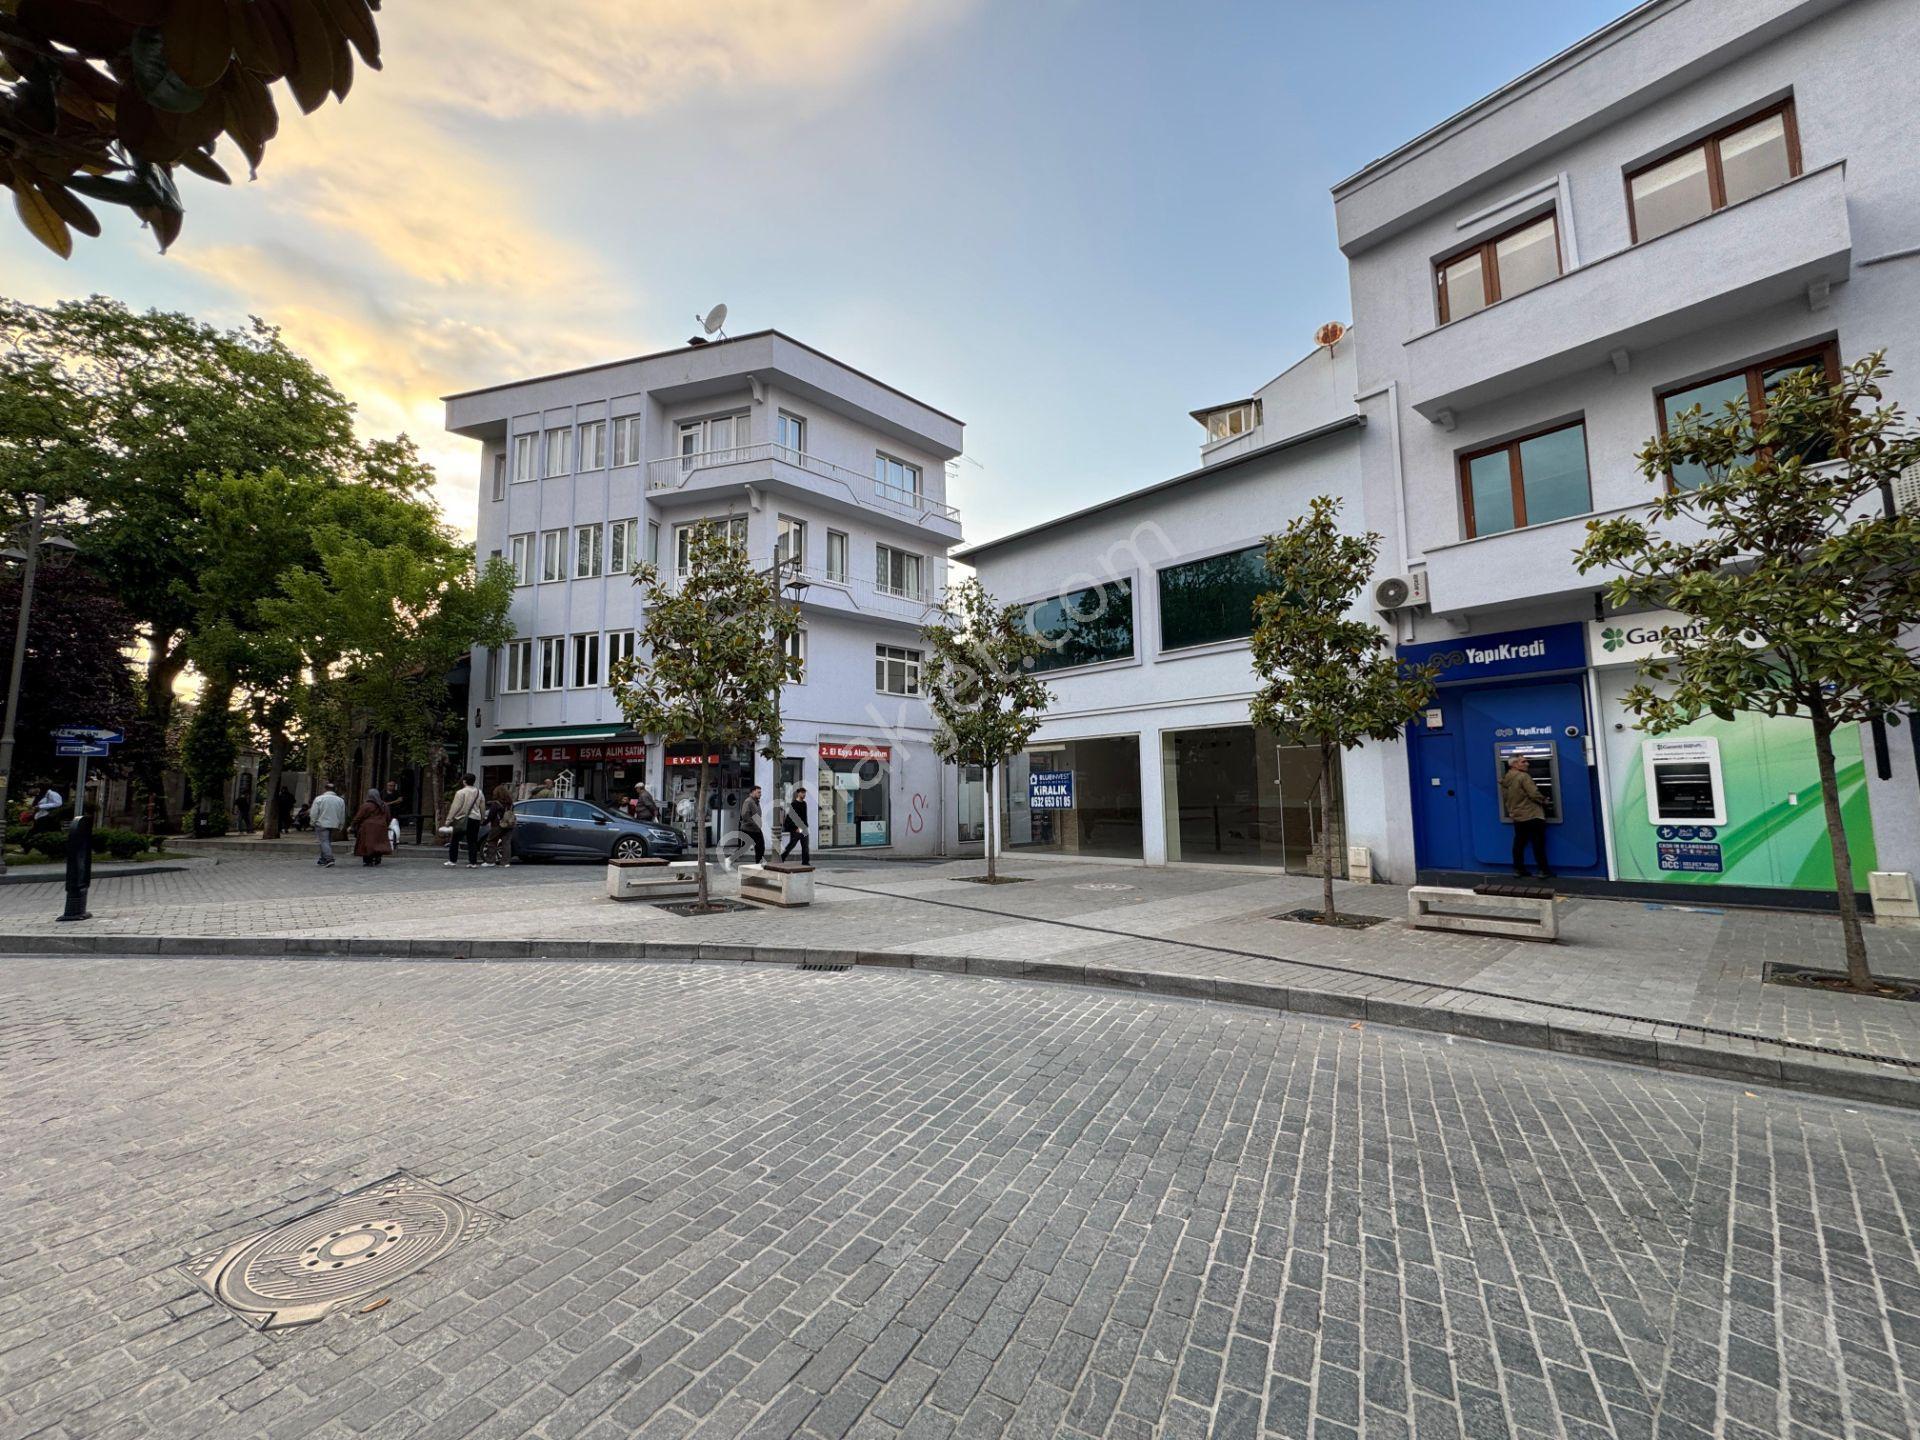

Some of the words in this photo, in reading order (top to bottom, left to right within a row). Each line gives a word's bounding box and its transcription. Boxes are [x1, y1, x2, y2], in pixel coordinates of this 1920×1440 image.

[1466, 639, 1545, 664] YapıKredi
[533, 747, 547, 761] 2.
[551, 747, 571, 760] EL
[580, 747, 602, 759] EŞYA
[606, 746, 624, 757] ALIM
[624, 745, 645, 756] SATIM
[821, 747, 829, 755] 2.
[830, 748, 836, 756] El
[837, 748, 852, 759] Eşya
[1031, 796, 1044, 807] 0532
[1055, 796, 1063, 807] 61
[1661, 861, 1680, 869] DCC
